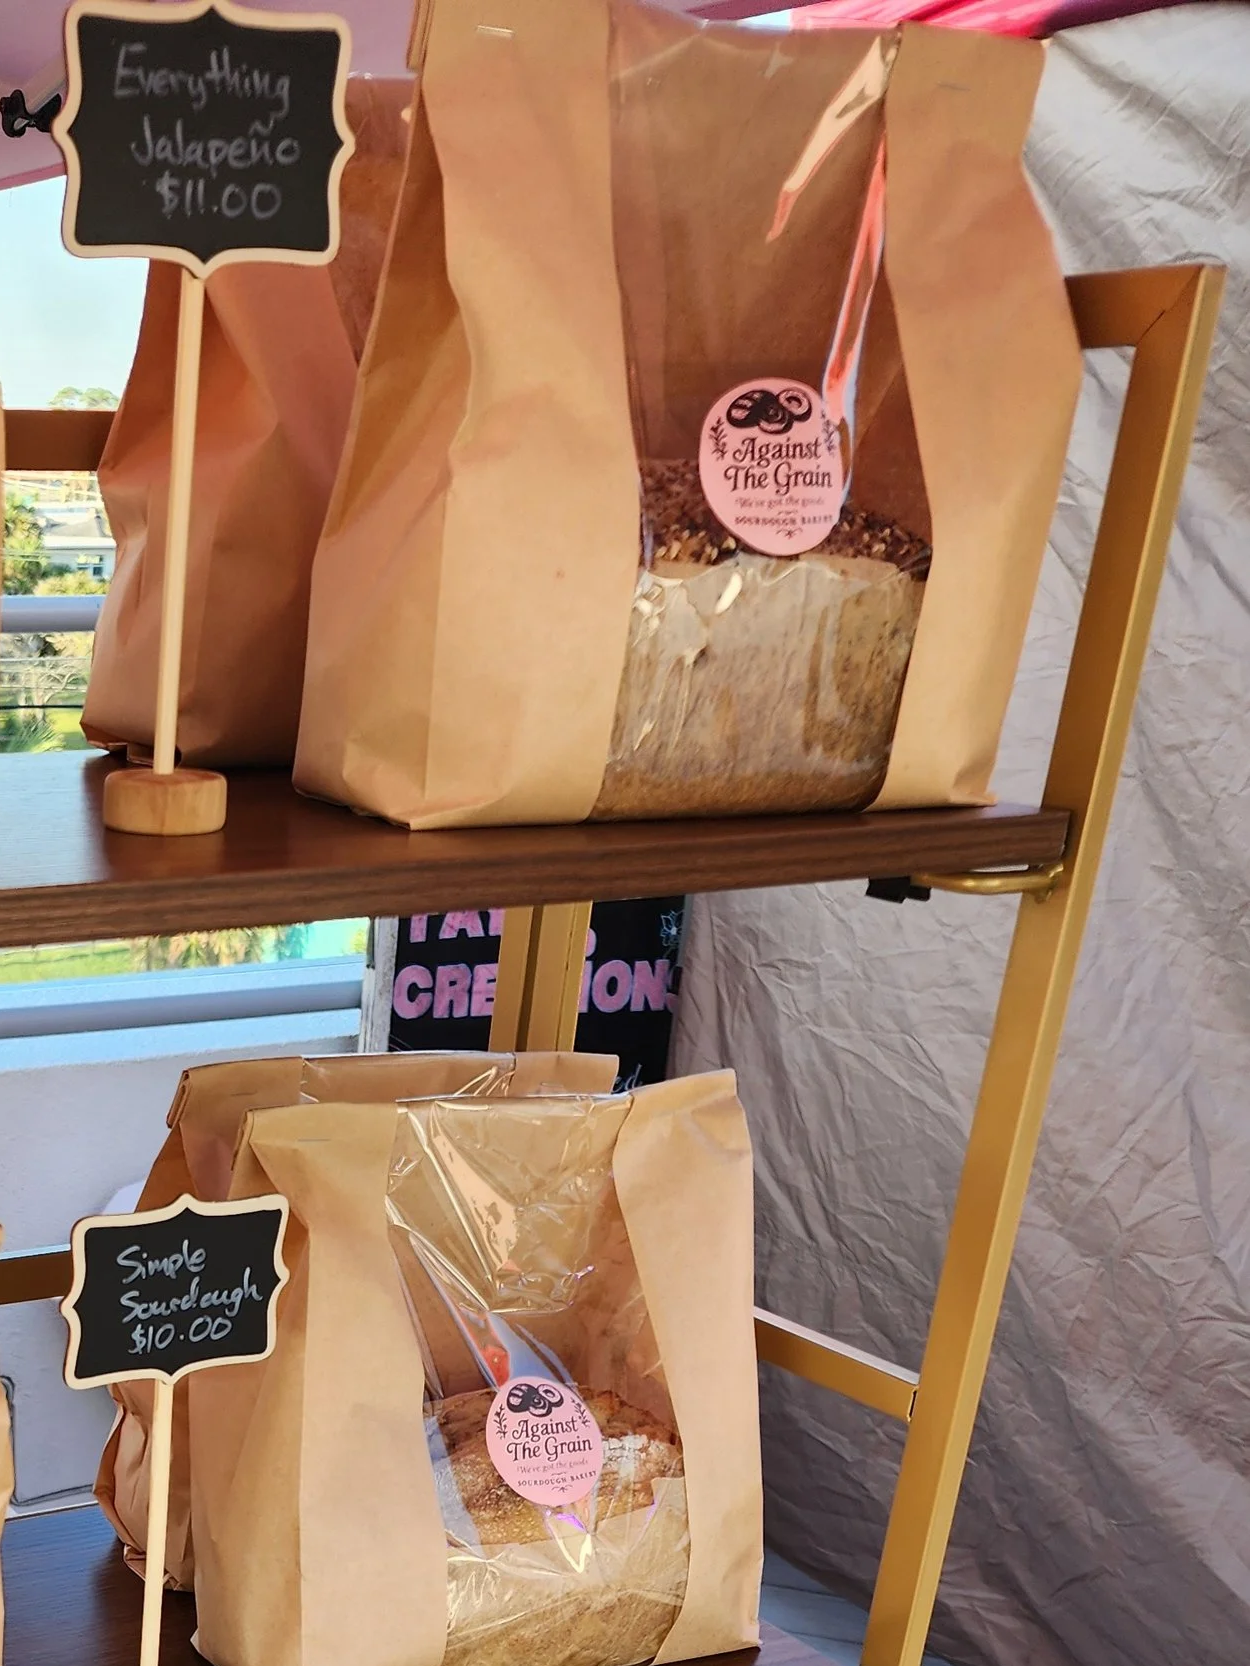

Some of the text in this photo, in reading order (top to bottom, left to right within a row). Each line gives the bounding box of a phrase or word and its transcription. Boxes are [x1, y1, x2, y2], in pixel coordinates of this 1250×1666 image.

[114, 42, 291, 120] Everything
[131, 113, 300, 179] Jalapeño
[155, 170, 282, 220] $11.00
[732, 437, 822, 467] Against
[724, 461, 833, 495] The Grain
[116, 1239, 206, 1284] Simple
[120, 1266, 263, 1323] Sourdough
[128, 1316, 232, 1354] $10.00
[506, 1435, 592, 1462] The Grain
[512, 1416, 578, 1442] Against
